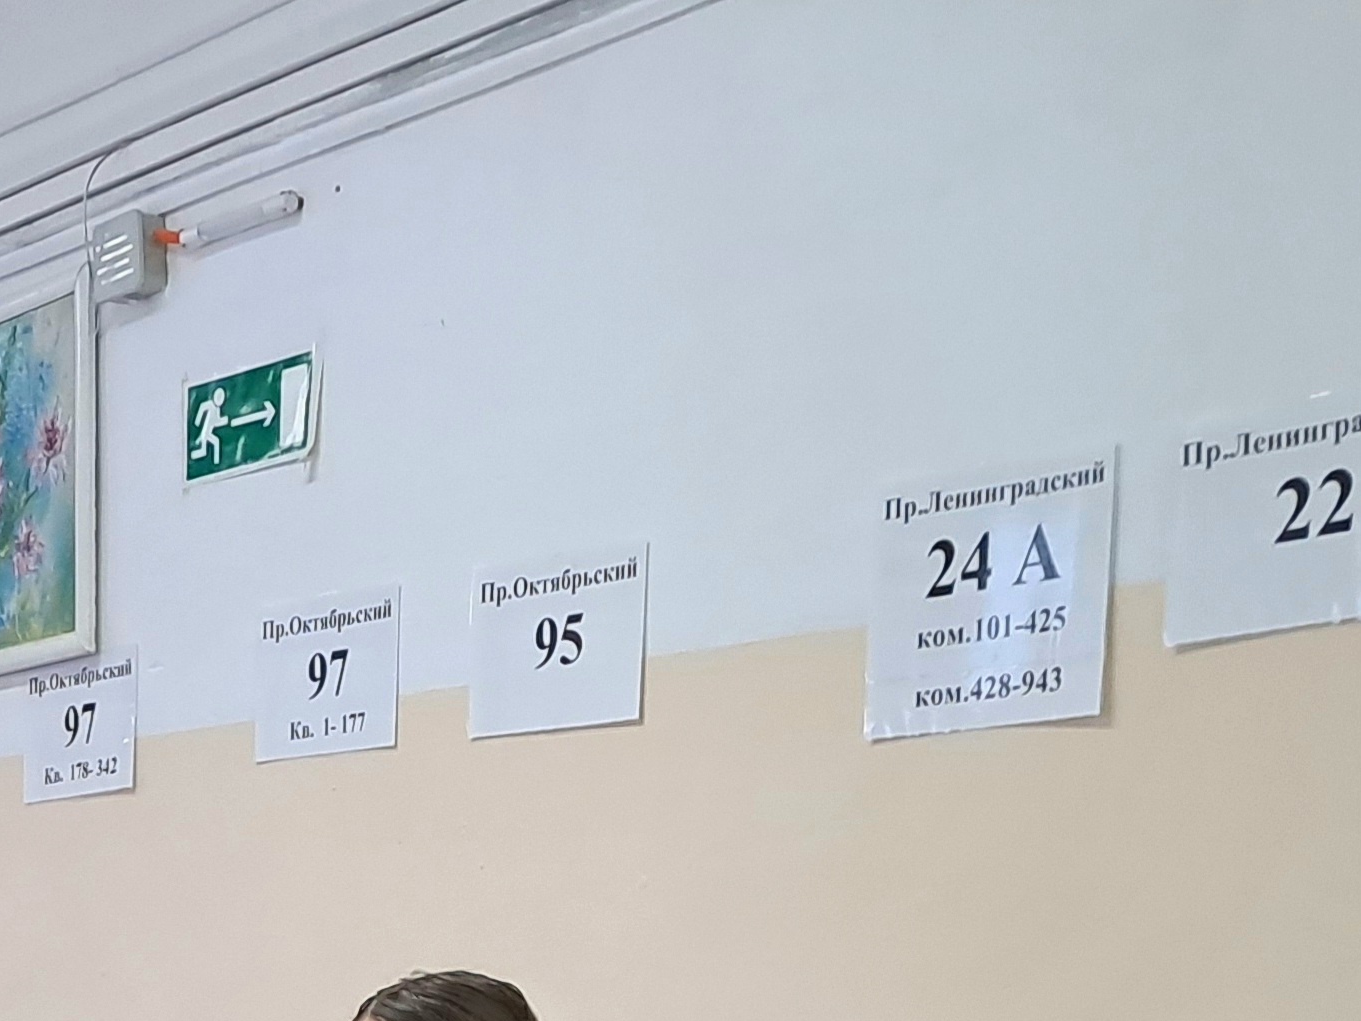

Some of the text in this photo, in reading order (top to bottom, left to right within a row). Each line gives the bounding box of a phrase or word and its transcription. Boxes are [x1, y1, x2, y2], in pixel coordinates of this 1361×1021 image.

[884, 461, 1106, 524] Пр.Ленинградский
[1274, 468, 1354, 544] 22
[480, 556, 638, 607] Пр.Октябрьский
[926, 523, 1061, 599] 24 А
[262, 598, 393, 643] Пр.Октябрьский
[535, 612, 584, 670] 95
[917, 605, 1067, 650] ком.101-425
[28, 658, 132, 698] Пр.Октябрьский
[308, 648, 349, 701] 97
[915, 666, 1063, 709] ком.428-943
[64, 702, 97, 749] 97
[289, 720, 315, 742] Кв.
[341, 711, 366, 734] 177
